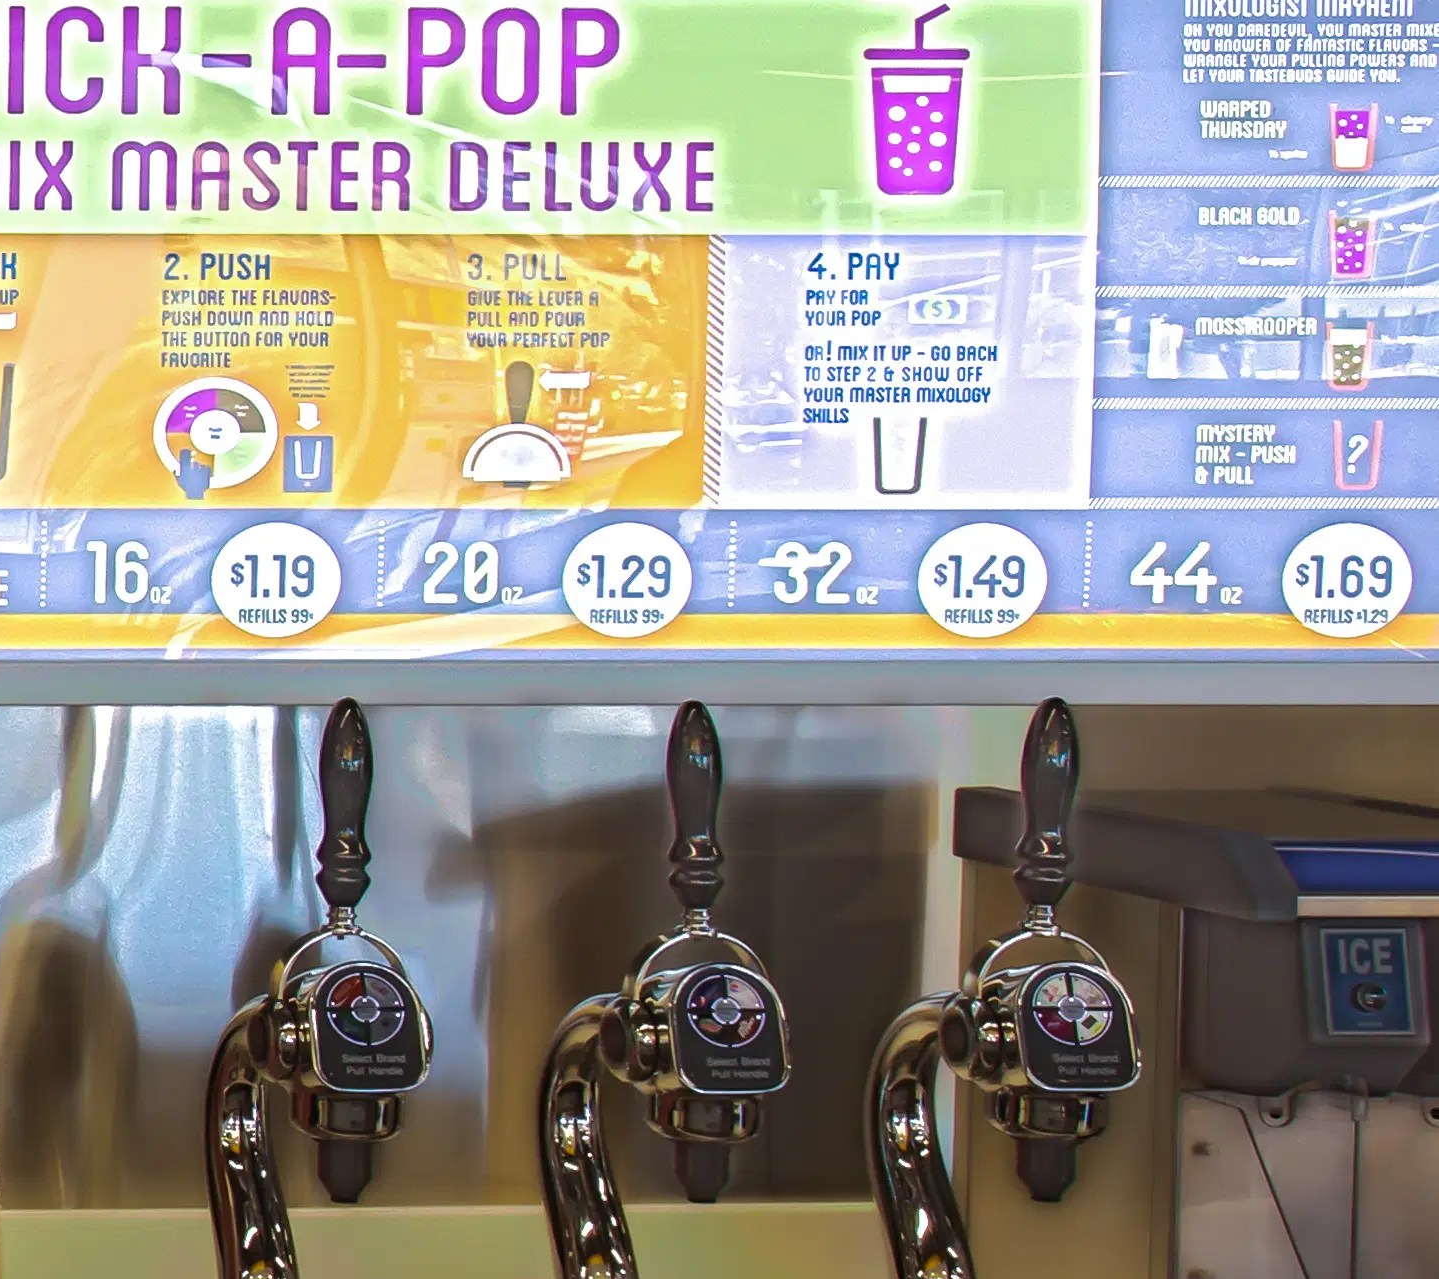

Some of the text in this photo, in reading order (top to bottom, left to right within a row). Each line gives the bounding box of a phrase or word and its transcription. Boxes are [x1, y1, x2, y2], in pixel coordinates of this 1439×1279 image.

[1184, 24, 1202, 37] OH
[1207, 24, 1233, 37] YOU
[1317, 24, 1343, 37] YOU
[1348, 24, 1401, 37] MASTER
[1183, 39, 1210, 52] YOU
[1275, 39, 1291, 52] OF
[1297, 39, 1364, 52] FANTASTIC
[1369, 39, 1427, 52] FLAVORS
[1183, 54, 1437, 67] WRANGLE YOUR PULLING POWERS AND
[1183, 69, 1204, 82] LET
[1209, 69, 1244, 82] YOUR
[1249, 69, 1322, 82] TASTEBUDS
[1327, 69, 1365, 82] GUIDE
[1200, 101, 1271, 118] WARPED
[1200, 121, 1287, 138] THURSDAY
[111, 141, 411, 211] MASTER
[449, 141, 715, 211] DELUXE
[1199, 207, 1300, 225] BLACK GOLD
[164, 253, 271, 280] 2. PUSH
[467, 253, 567, 280] 3. PULL
[807, 253, 900, 280] 4. PAY
[162, 290, 227, 305] EXPLORE
[231, 290, 259, 305] THE
[467, 291, 599, 306] GIVE THE LEVER A
[806, 290, 868, 305] PAY FOR
[162, 311, 334, 326] PUSH DOWN AND HOLD
[467, 312, 585, 327] PULL AND POUR
[805, 311, 881, 326] YOUR POP
[162, 332, 329, 347] THE BUTTON FOR YOUR
[467, 332, 610, 347] YOUR PERFECT POP
[804, 340, 998, 361] OR! MIX IT UP GO BACK
[161, 353, 231, 368] FAVORITE
[804, 367, 983, 382] TO STEP 2 SHOW OFF
[803, 387, 991, 403] YOUR MASTER MIXOLOGY
[803, 408, 849, 423] SKILLS
[1196, 425, 1275, 442] MYSTERY
[1195, 445, 1296, 463] MIX PUSH
[1213, 466, 1254, 484] PULL
[86, 541, 150, 604] 16
[231, 555, 316, 599] $1.19
[422, 541, 498, 604] 20
[577, 555, 671, 599] $1.29
[773, 541, 852, 604] 32
[934, 555, 1026, 599] $1.49
[1130, 541, 1217, 604] 44
[1296, 555, 1393, 599] $1.69
[238, 609, 287, 624] REFILLS
[590, 609, 638, 624] REFILLS
[945, 609, 993, 624] REFILLS
[1304, 609, 1352, 624] REFILLS
[1337, 937, 1394, 975] ICE
